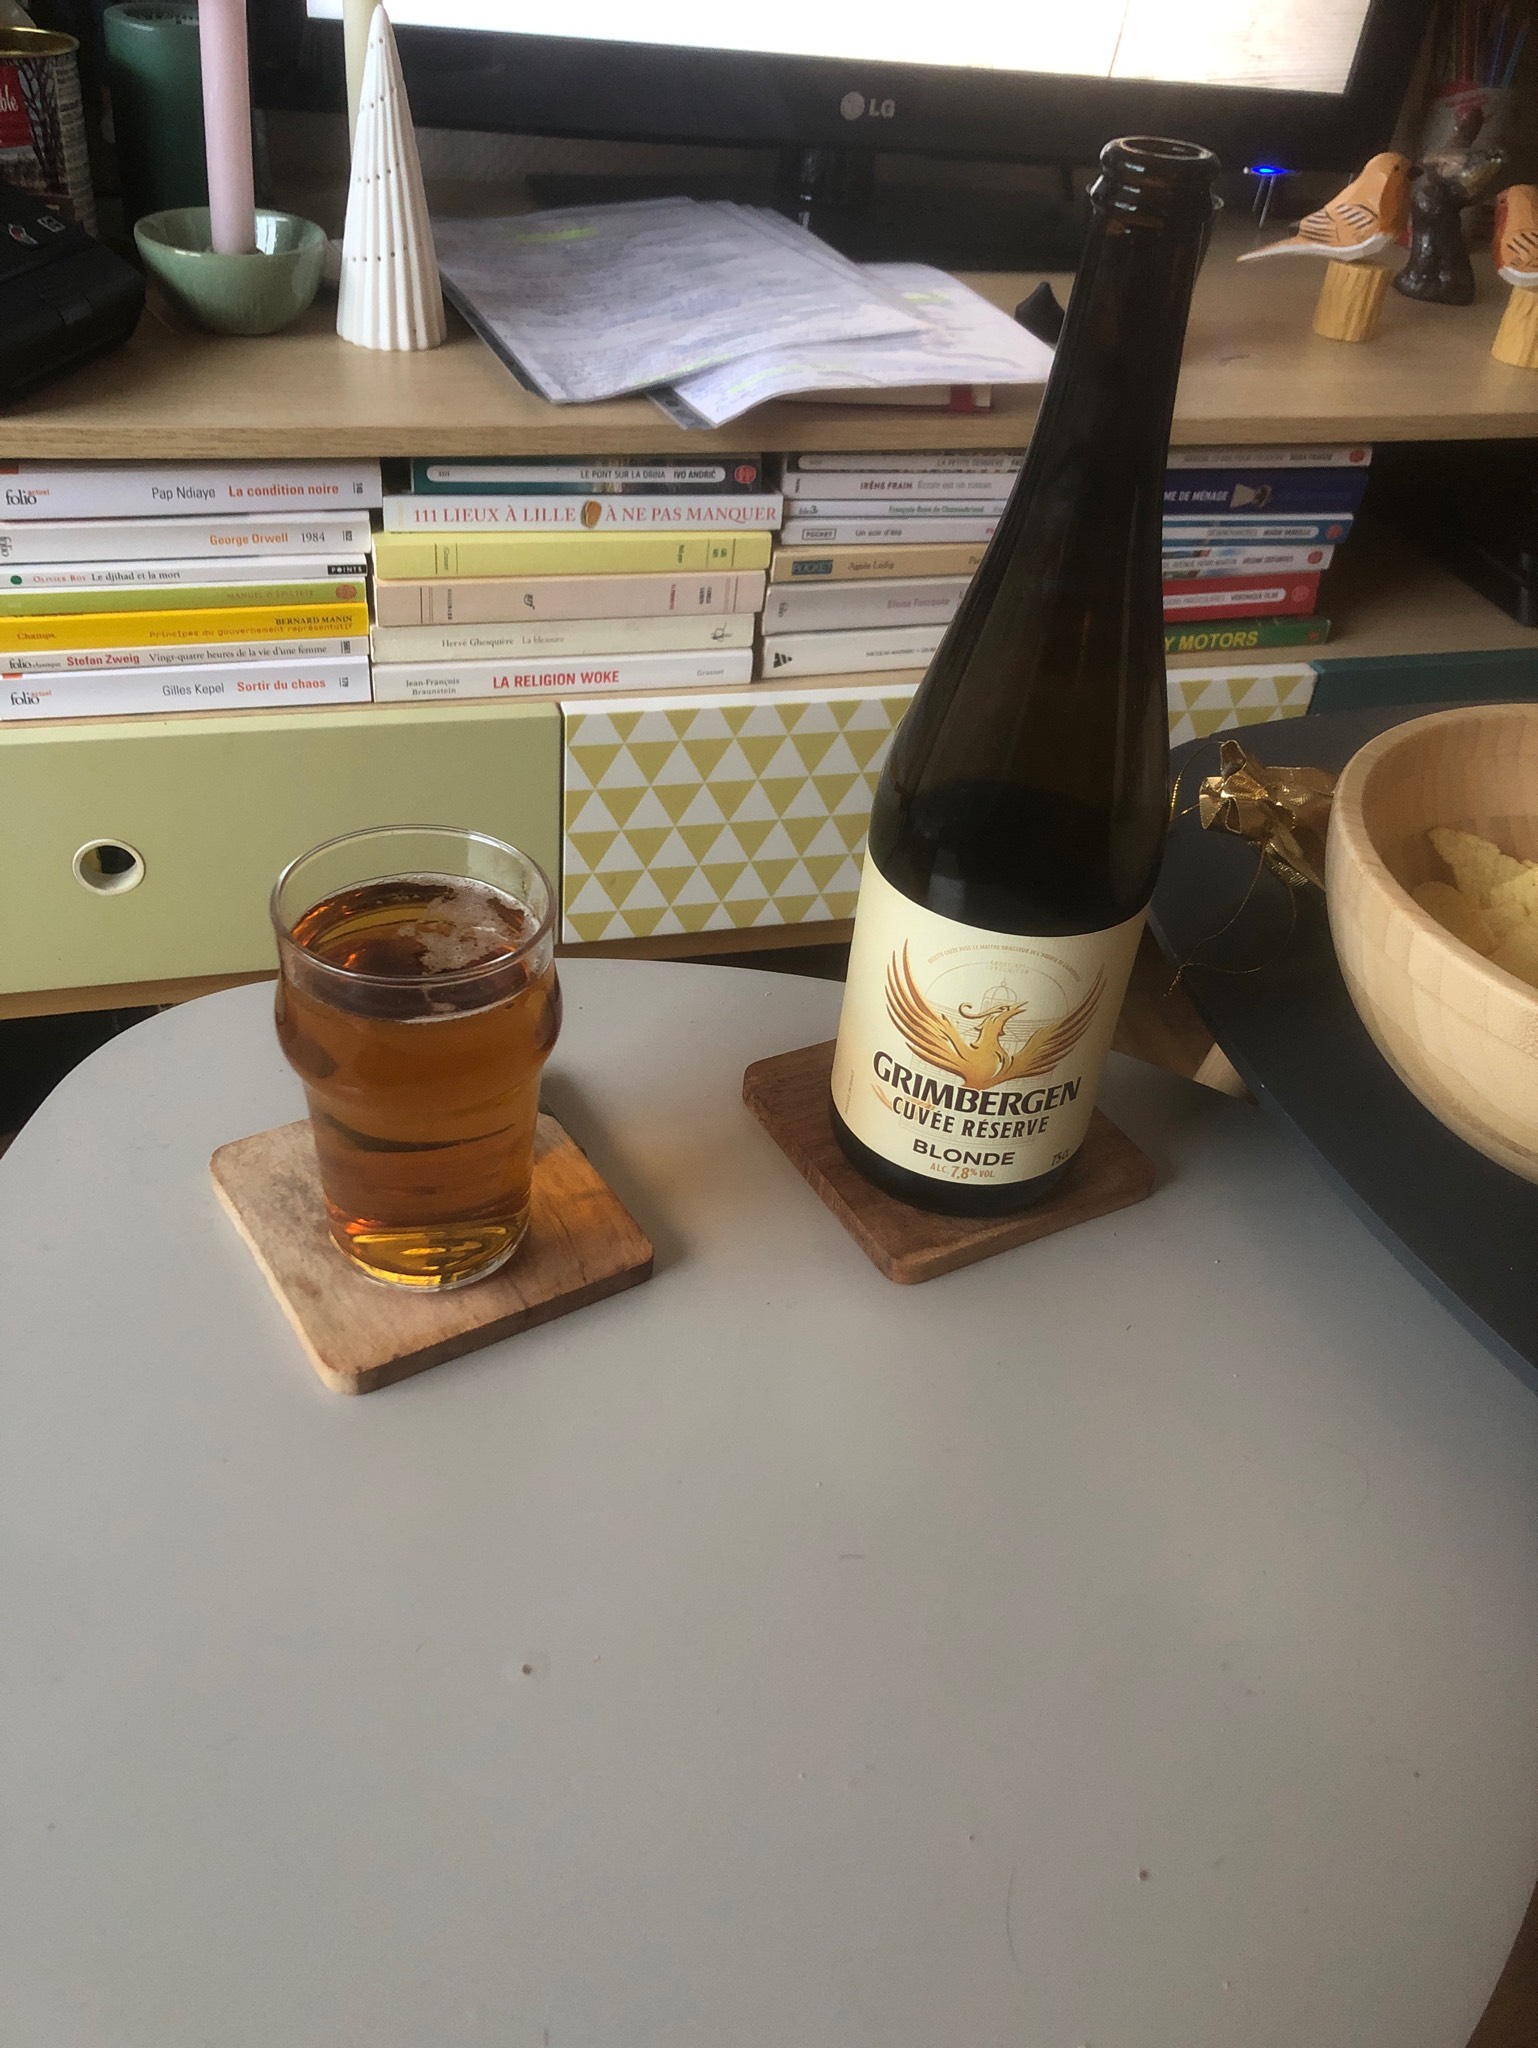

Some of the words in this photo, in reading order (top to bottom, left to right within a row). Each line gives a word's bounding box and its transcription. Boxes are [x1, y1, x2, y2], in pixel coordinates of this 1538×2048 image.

[869, 98, 895, 118] LG
[580, 471, 588, 479] LE
[592, 470, 612, 479] PONT
[615, 470, 629, 478] SUR
[632, 470, 641, 478] LA
[643, 470, 666, 479] DRINA
[673, 470, 686, 479] IVO
[229, 485, 243, 496] La
[247, 483, 303, 496] condition
[308, 483, 339, 494] noire
[886, 482, 913, 490] FRAIN
[5, 489, 37, 505] folio
[152, 487, 172, 501] Pap
[177, 486, 216, 500] Ndiaye
[415, 509, 438, 522] 111
[443, 508, 500, 522] LIEUX
[505, 505, 517, 522] À
[523, 508, 576, 521] LILLE
[605, 504, 617, 521] À
[622, 507, 646, 521] NE
[651, 507, 682, 521] PAS
[686, 507, 776, 524] MANQUER
[210, 535, 249, 546] George
[252, 533, 288, 544] Orwell
[301, 532, 325, 542] 1984
[91, 573, 103, 581] Le
[105, 571, 134, 582] djihad
[137, 571, 146, 580] et
[148, 571, 156, 579] la
[159, 570, 181, 579] mort
[275, 617, 319, 625] BERNARD
[149, 630, 199, 638] Principes
[217, 626, 284, 637] gouvernement
[442, 639, 468, 647] Hervé
[522, 636, 531, 644] La
[1178, 630, 1259, 650] MOTORS
[149, 651, 205, 664] Vingt-quatre
[206, 649, 234, 660] heures
[236, 648, 247, 658] de
[249, 647, 257, 657] la
[259, 646, 271, 656] vie
[273, 645, 296, 656] d'une
[298, 643, 328, 654] femme
[9, 659, 32, 669] folio
[66, 656, 103, 666] Stefan
[105, 654, 140, 664] Zweig
[237, 680, 270, 692] Sortir
[274, 679, 289, 690] du
[292, 678, 326, 689] chaos
[493, 676, 509, 689] LA
[514, 673, 576, 687] RELIGION
[580, 670, 620, 684] WOKE
[162, 683, 192, 697] Gilles
[195, 682, 225, 695] Kepel
[412, 688, 456, 696] Braunstein
[10, 691, 40, 706] folio
[873, 1051, 1082, 1116] GRIMBERGEN
[892, 1096, 955, 1133] CUVÉE
[961, 1115, 1049, 1139] RÉSERVE
[912, 1138, 1016, 1166] BLONDE
